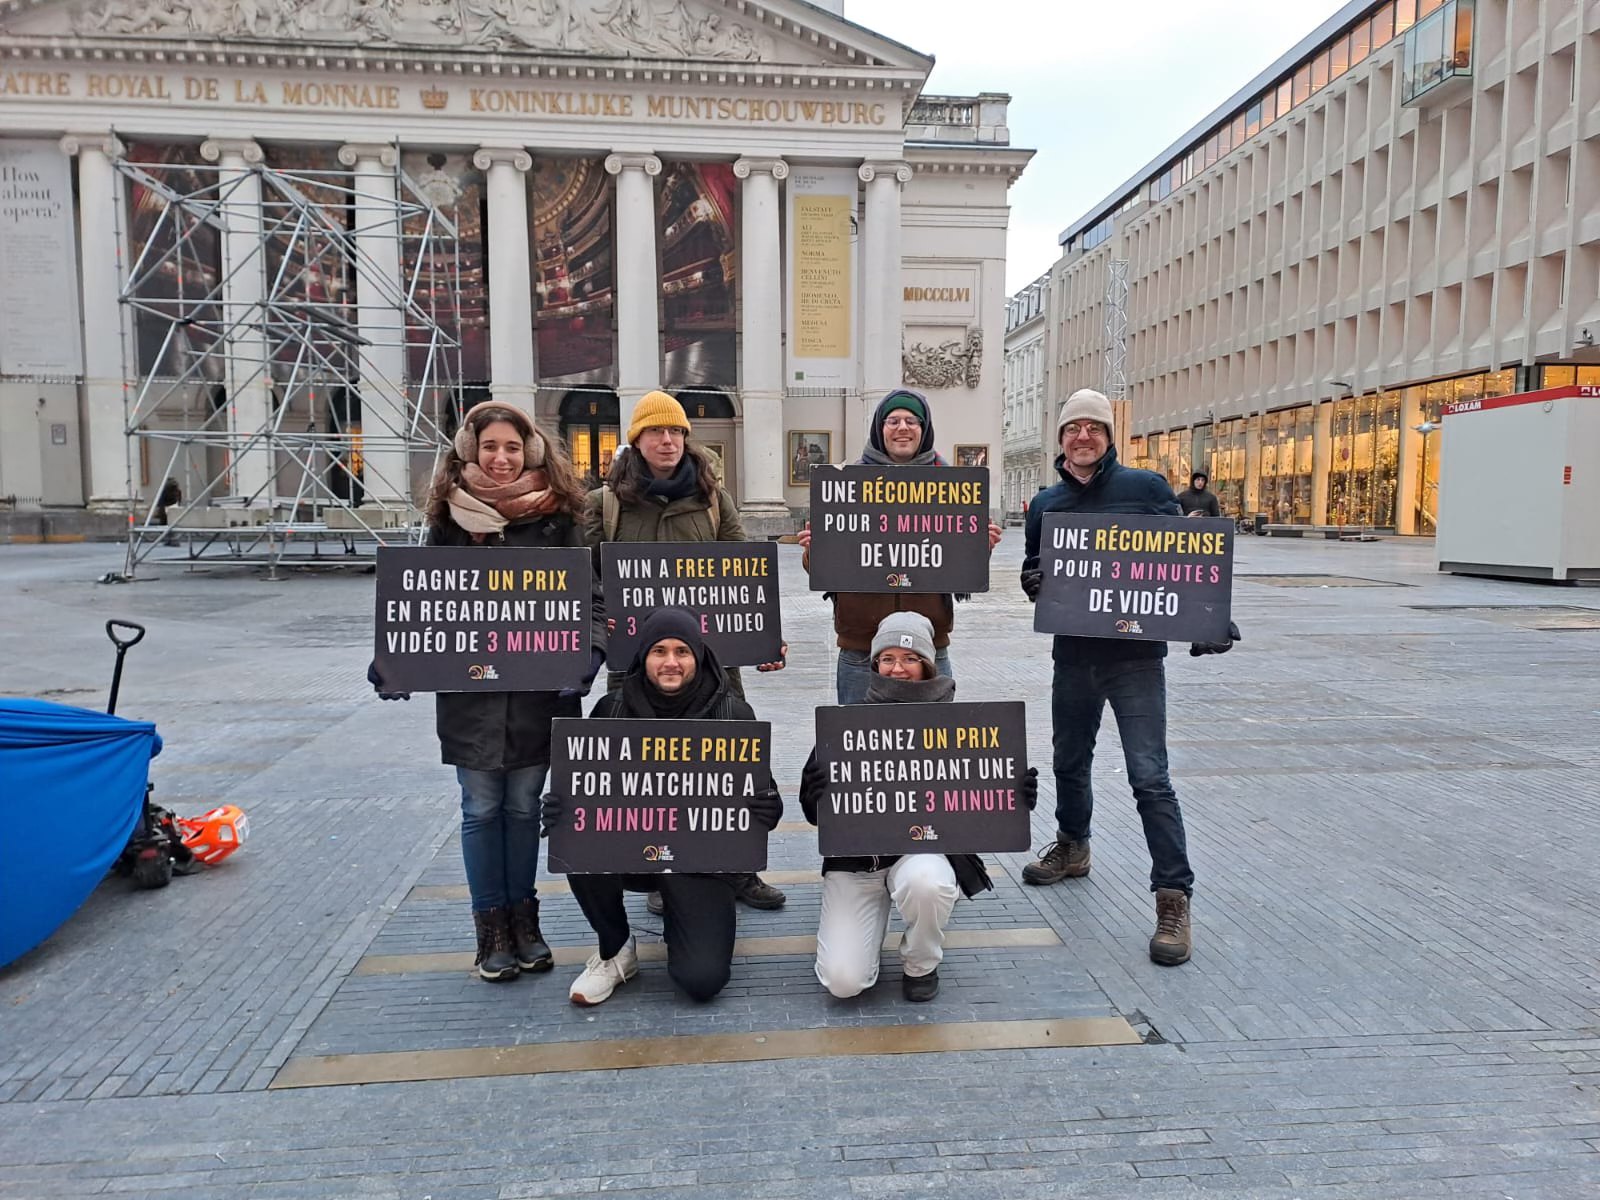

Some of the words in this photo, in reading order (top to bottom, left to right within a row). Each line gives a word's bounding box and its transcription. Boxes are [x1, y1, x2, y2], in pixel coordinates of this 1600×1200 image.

[0, 71, 71, 96] ATRE
[87, 73, 171, 99] ROYAL
[183, 76, 219, 101] DE
[234, 79, 268, 104] LA
[282, 81, 400, 109] MONNAIE
[469, 87, 633, 117] KONINKLIJKE
[646, 94, 887, 126] MUNTSCHOUWBURG
[3, 167, 39, 181] How
[2, 184, 50, 200] about
[3, 202, 61, 222] opera?
[903, 287, 970, 302] MDCCCLVI
[1455, 401, 1482, 412] LOXAM
[821, 480, 856, 503] UNE
[862, 476, 982, 504] RÉCOMPENSE
[824, 513, 870, 532] POUR
[879, 514, 888, 533] 3
[898, 514, 978, 534] MINUTES
[1053, 527, 1089, 550] UNE
[1095, 524, 1225, 555] RÉCOMPENSE
[861, 543, 883, 568] DE
[889, 538, 943, 568] VIDÉO
[402, 569, 480, 591] GAGNEZ
[488, 569, 514, 591] UN
[522, 570, 568, 591] PRIX
[617, 559, 651, 579] WIN
[659, 558, 669, 578] A
[676, 558, 715, 578] FREE
[722, 557, 769, 577] PRIZE
[1053, 559, 1102, 578] POUR
[1111, 561, 1121, 579] 3
[1130, 562, 1220, 583] MINUTES
[622, 587, 655, 607] FOR
[662, 585, 749, 606] WATCHING
[756, 585, 766, 604] A
[1089, 588, 1113, 613] DE
[1119, 587, 1179, 616] VIDÉO
[386, 600, 410, 622] EN
[420, 600, 536, 622] REGARDANT
[544, 600, 581, 621] UNE
[627, 616, 637, 636] 3
[715, 612, 764, 633] VIDEO
[386, 626, 446, 653] VIDÉO
[455, 631, 479, 653] DE
[487, 630, 498, 652] 3
[507, 630, 581, 652] MINUTE
[567, 736, 610, 761] WIN
[619, 737, 632, 761] A
[641, 737, 691, 761] FREE
[701, 737, 761, 762] PRIZE
[843, 728, 915, 752] GAGNEZ
[922, 728, 948, 749] UN
[956, 727, 1000, 749] PRIX
[829, 761, 851, 783] EN
[861, 758, 971, 782] REGARDANT
[978, 757, 1015, 780] UNE
[571, 772, 611, 796] FOR
[621, 772, 733, 797] WATCHING
[743, 773, 755, 797] A
[831, 787, 886, 815] VIDÉO
[895, 791, 917, 813] DE
[925, 790, 936, 812] 3
[944, 789, 1016, 812] MINUTE
[574, 807, 586, 832] 3
[596, 807, 678, 832] MINUTE
[687, 807, 750, 832] VIDEO
